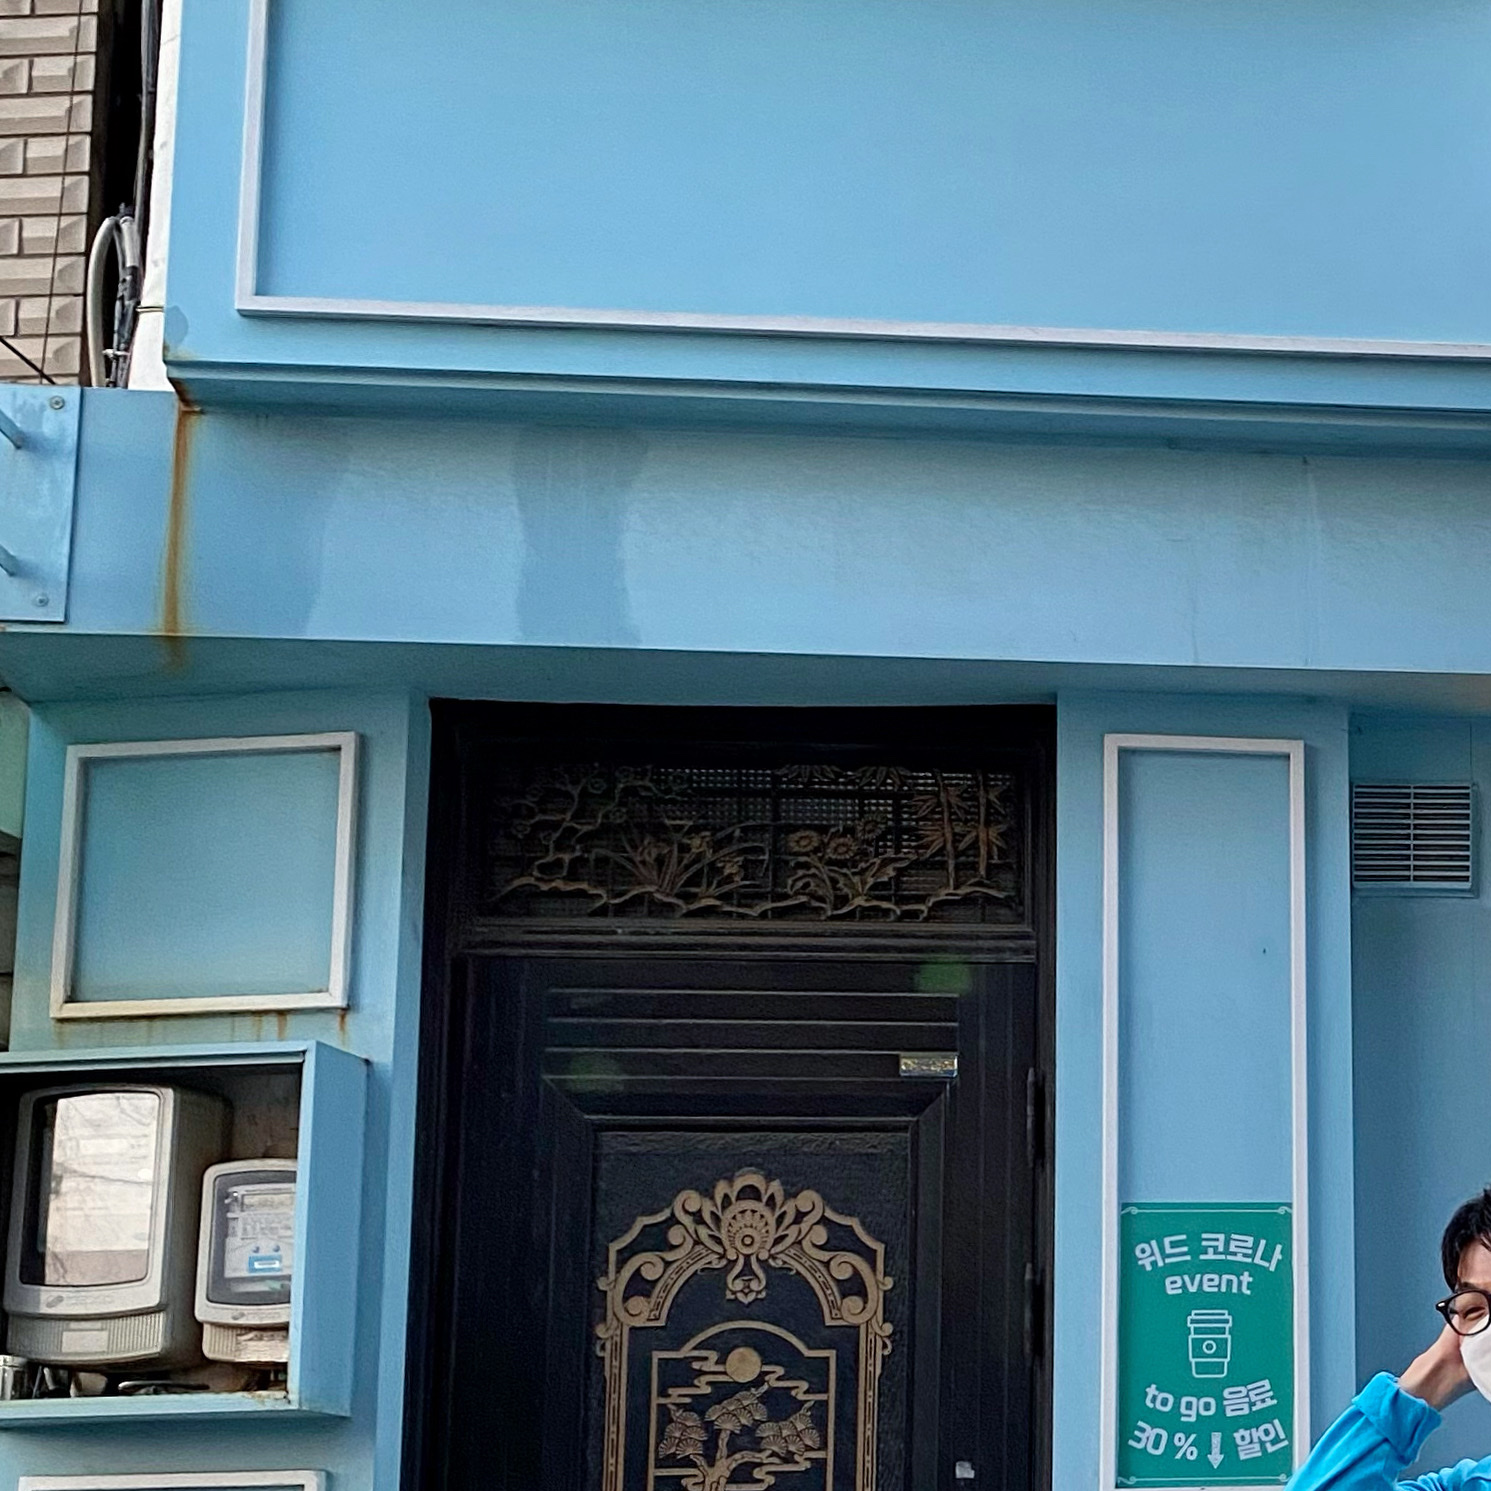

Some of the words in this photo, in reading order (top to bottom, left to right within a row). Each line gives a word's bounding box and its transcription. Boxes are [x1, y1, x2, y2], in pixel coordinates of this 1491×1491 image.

[1134, 1233, 1192, 1272] 위드
[1199, 1232, 1283, 1272] 코로나
[1165, 1271, 1253, 1295] event
[1145, 1384, 1174, 1412] to
[1179, 1396, 1216, 1422] go
[1222, 1379, 1278, 1417] 음료
[1128, 1420, 1168, 1455] 30
[1173, 1432, 1198, 1461] %
[1233, 1418, 1289, 1461] 할인
